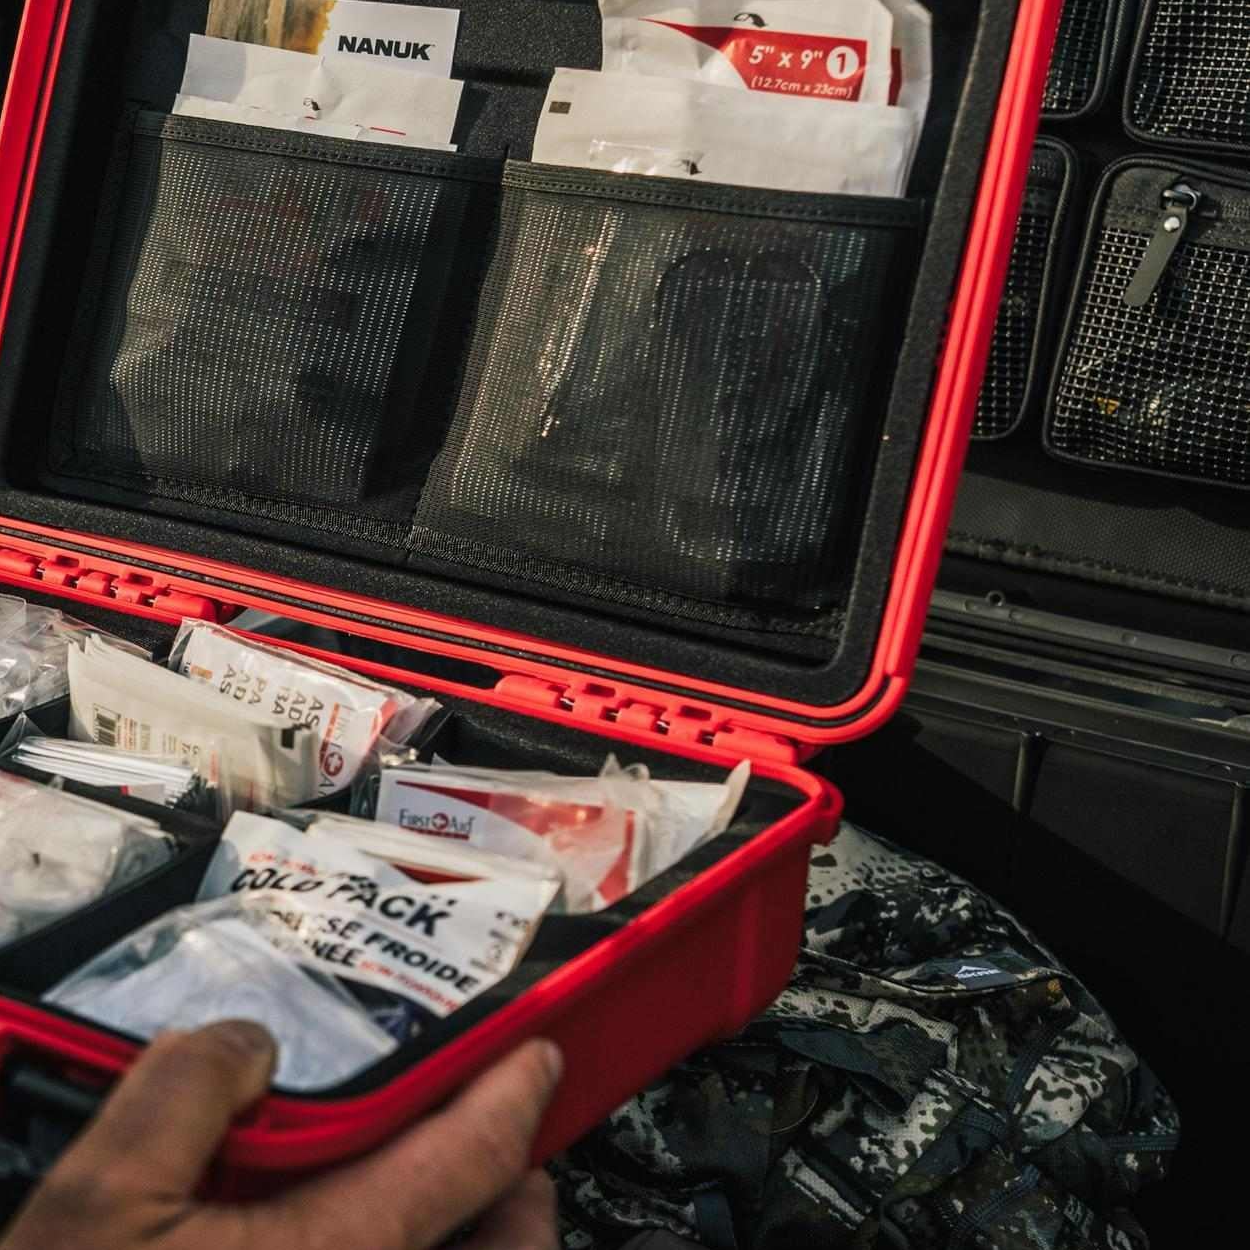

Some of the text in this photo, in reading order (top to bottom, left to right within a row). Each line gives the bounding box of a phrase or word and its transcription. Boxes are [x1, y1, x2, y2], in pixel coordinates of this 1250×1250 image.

[338, 35, 432, 61] NANUK
[748, 44, 775, 65] 5"
[777, 51, 793, 69] x
[800, 49, 824, 70] 9"
[751, 75, 801, 93] (12.7cm
[364, 931, 481, 994] FROIDE
